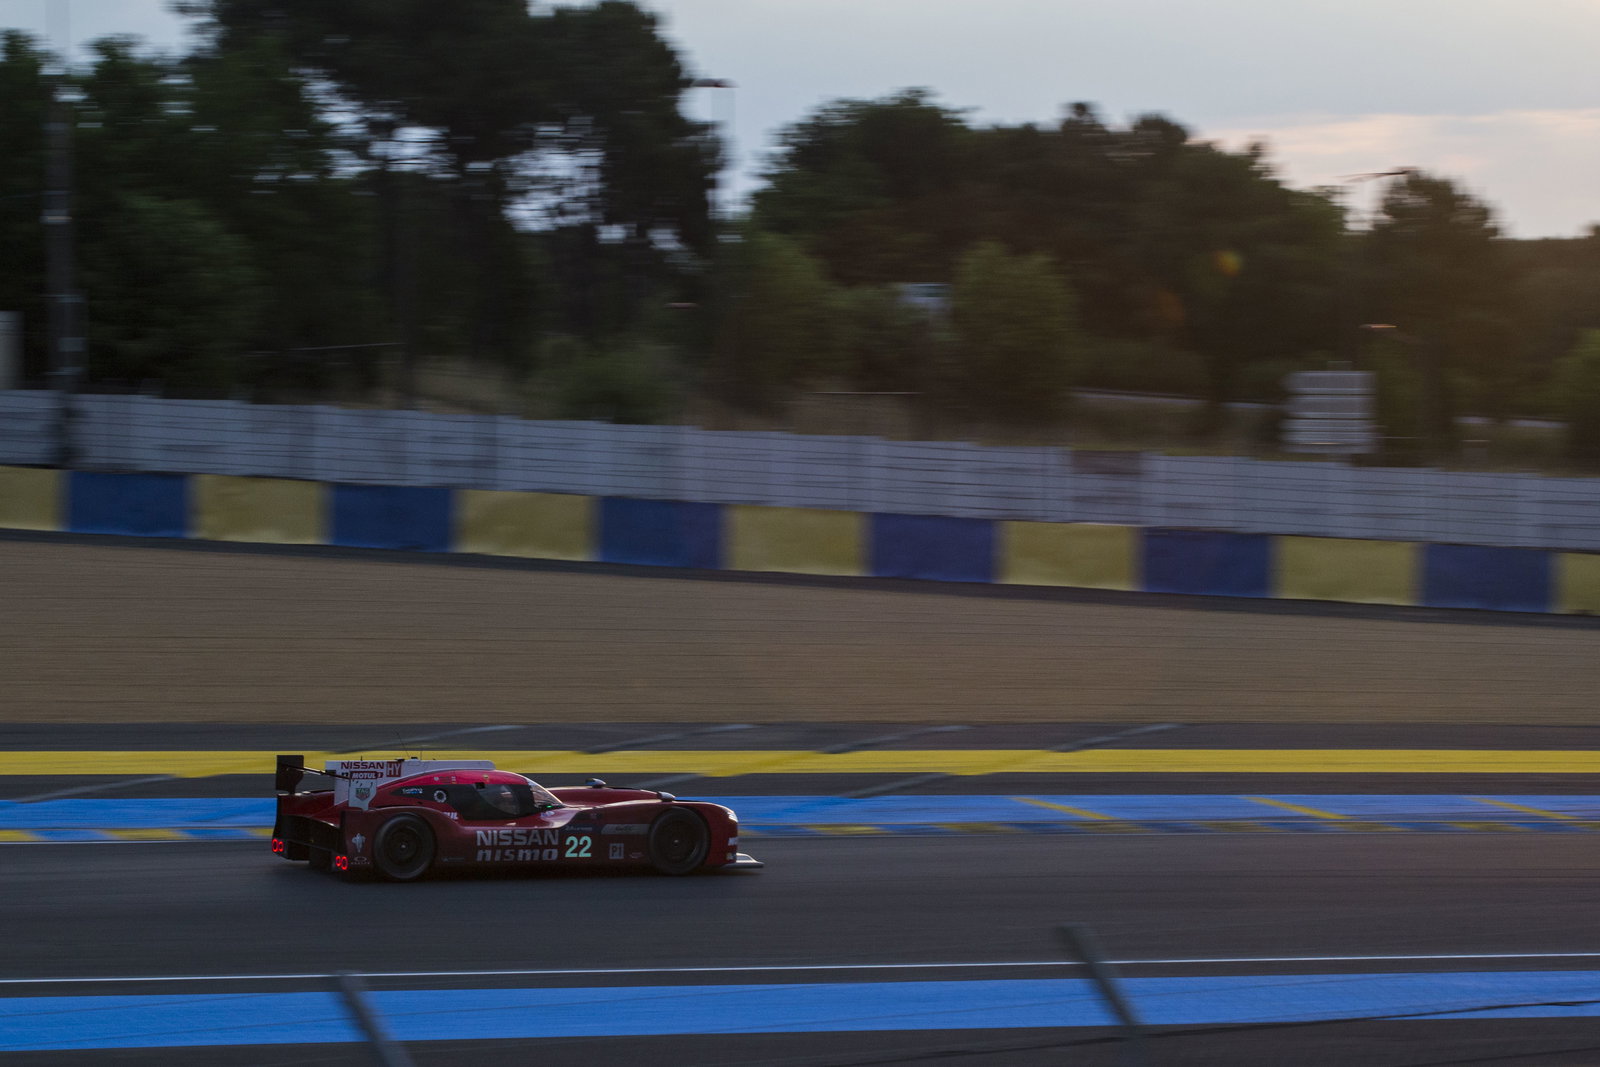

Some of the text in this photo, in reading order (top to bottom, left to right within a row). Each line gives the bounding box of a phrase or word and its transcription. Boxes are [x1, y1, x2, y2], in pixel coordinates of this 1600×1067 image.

[341, 761, 384, 770] NISSAN
[387, 762, 400, 776] HY
[476, 829, 560, 846] NISSAN
[565, 836, 592, 858] 22
[476, 849, 559, 862] nismo
